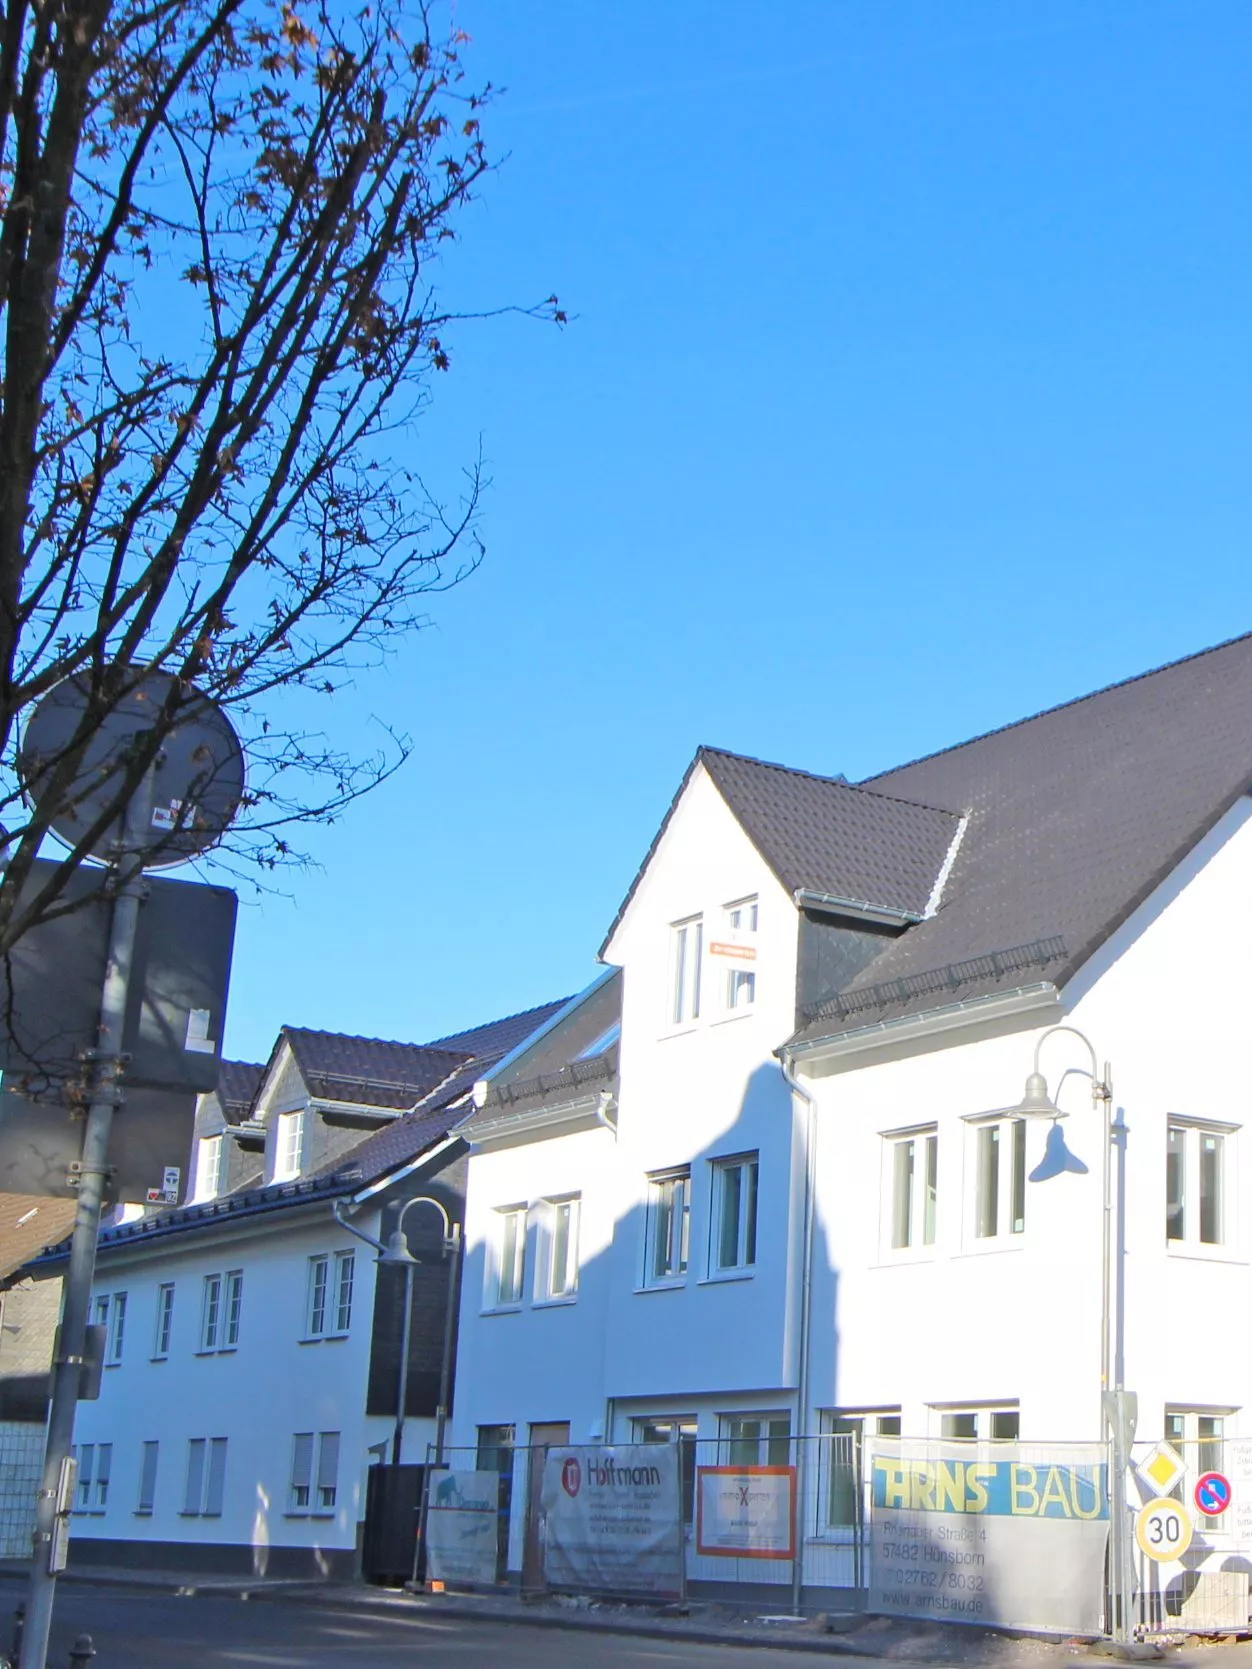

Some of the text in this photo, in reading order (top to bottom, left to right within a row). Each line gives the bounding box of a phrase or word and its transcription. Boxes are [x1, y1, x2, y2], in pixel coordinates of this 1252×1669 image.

[587, 1457, 661, 1486] Hoffmann
[875, 1457, 1101, 1519] ARNS BAU
[1149, 1515, 1180, 1544] 30
[883, 1543, 985, 1566] 57482 Hünsborn
[882, 1591, 984, 1614] www.arnsbau.de
